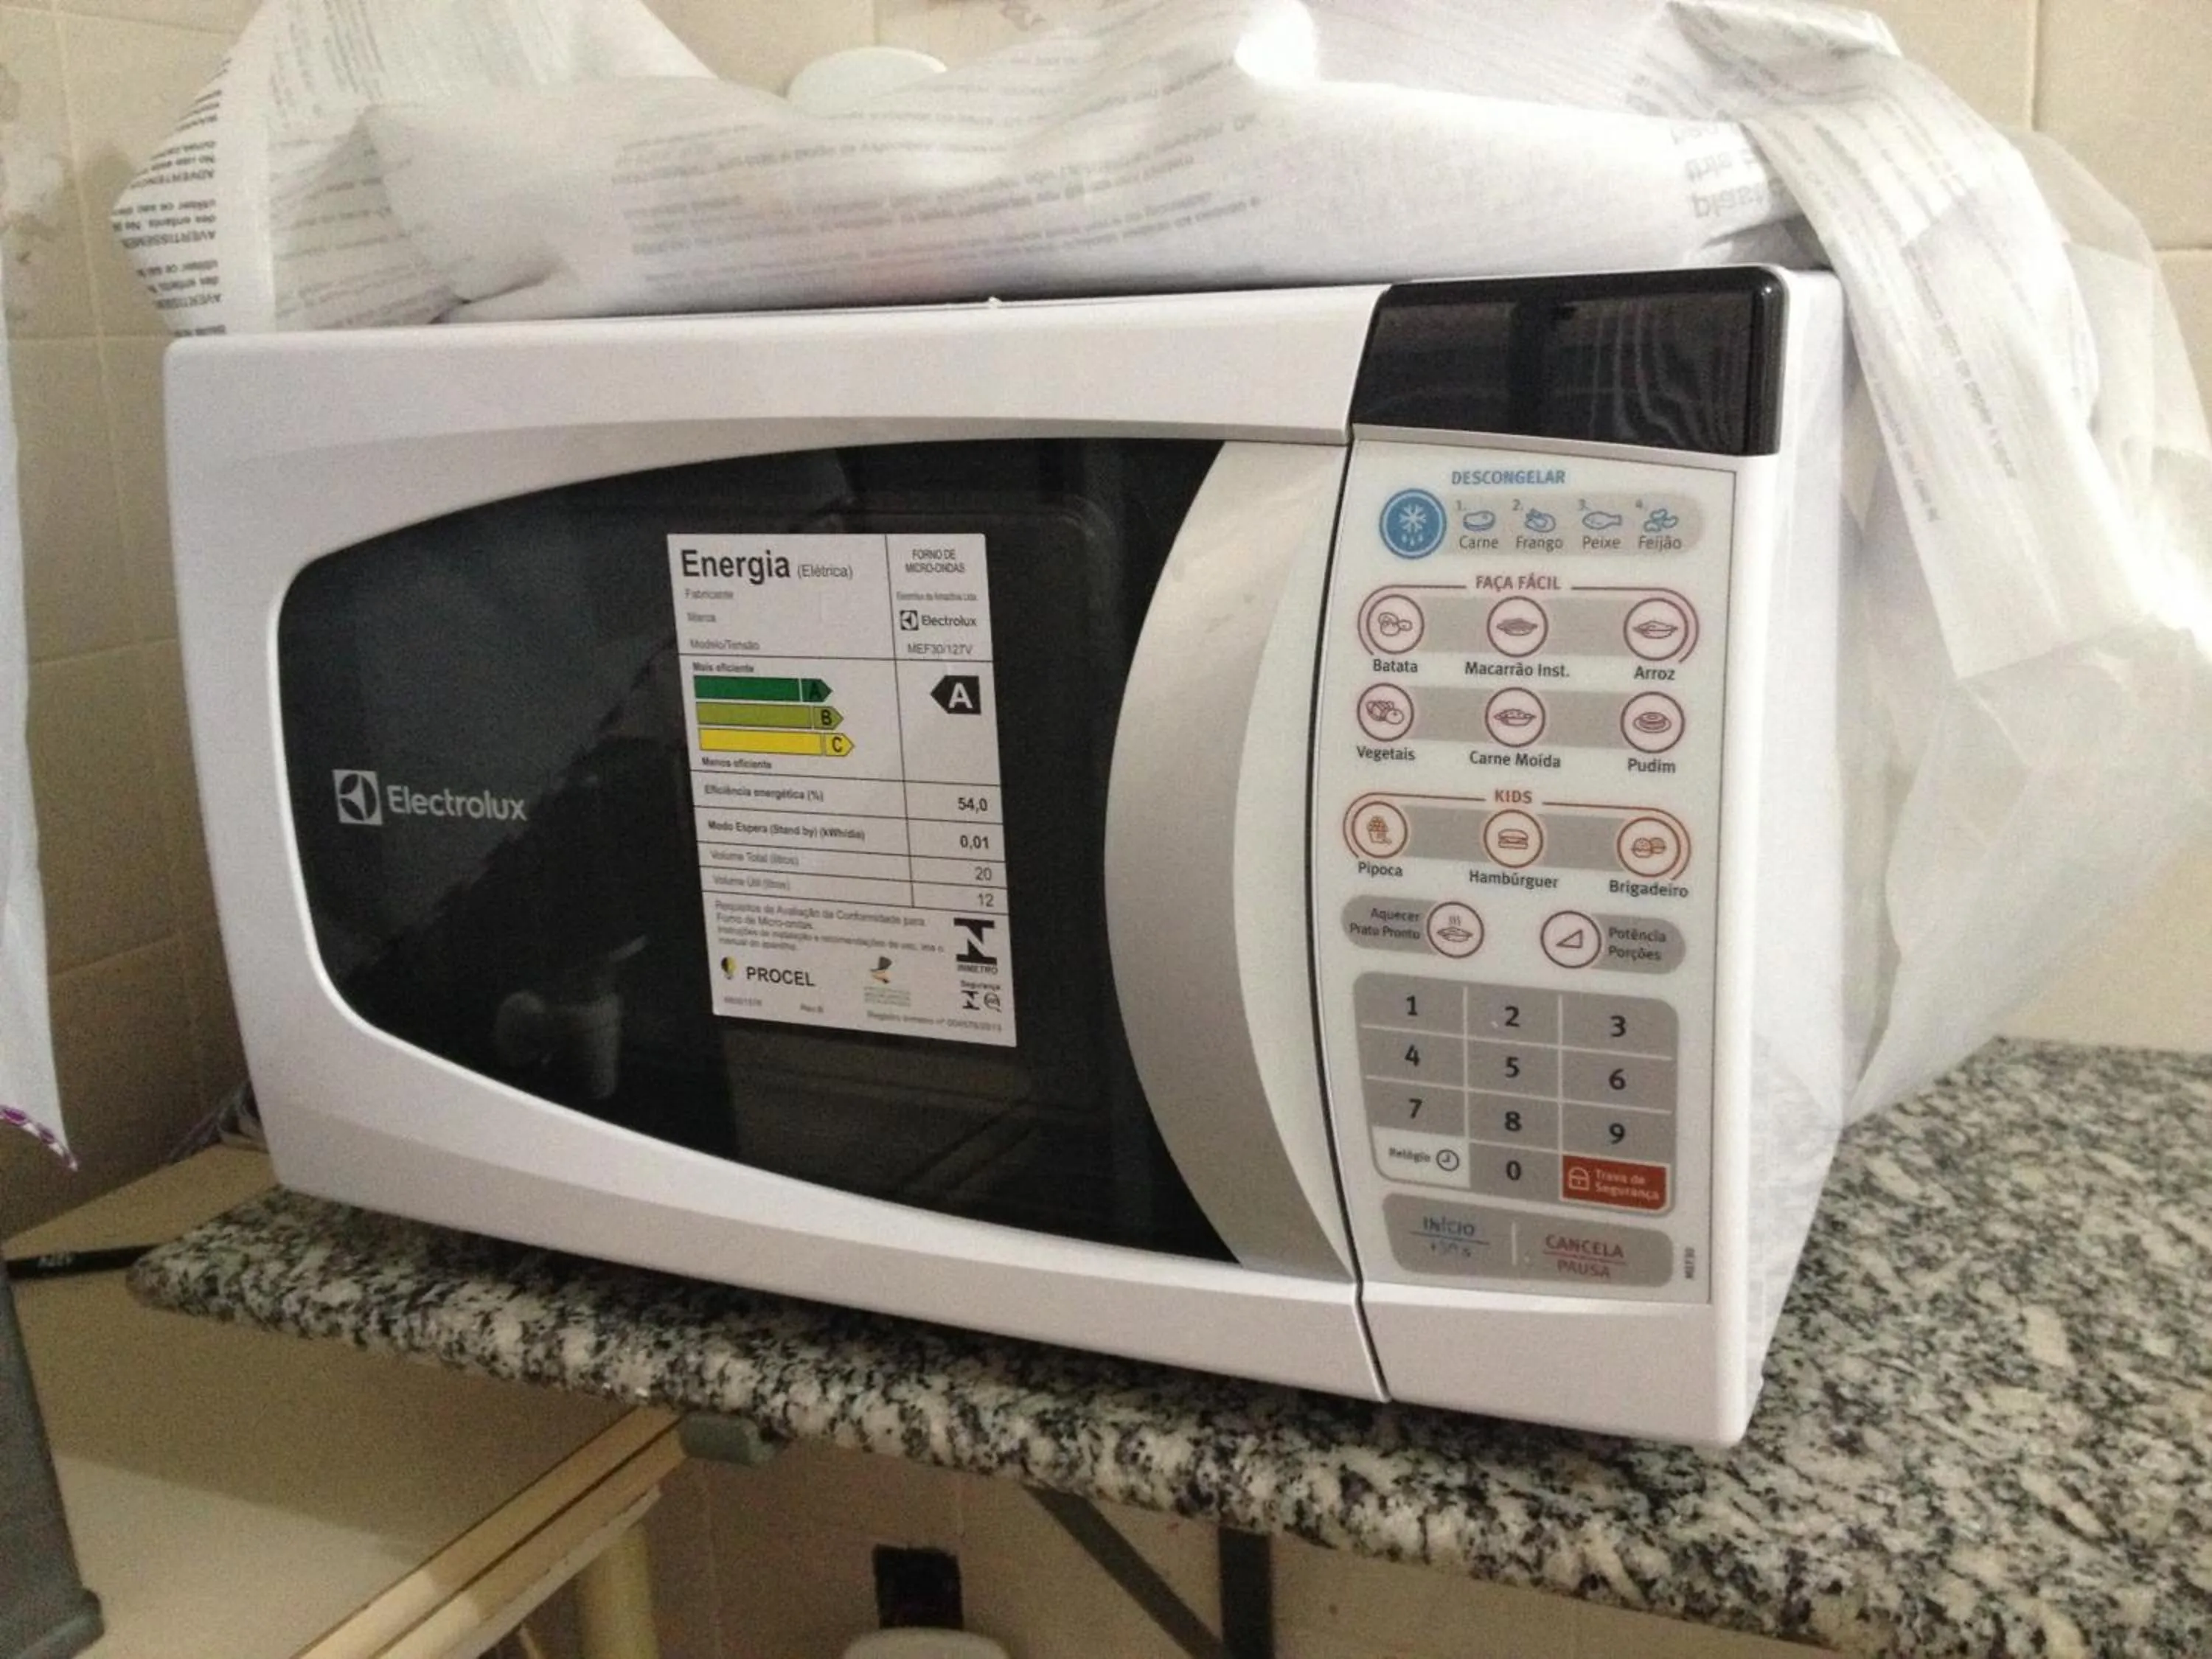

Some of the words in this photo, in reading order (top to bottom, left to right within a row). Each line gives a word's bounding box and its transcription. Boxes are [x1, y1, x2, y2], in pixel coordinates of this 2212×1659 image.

[1452, 470, 1566, 485] DESCONGELAR
[1459, 535, 1498, 550] Carne
[1516, 535, 1564, 552] Frango
[1582, 536, 1621, 550] Peixe
[1638, 535, 1682, 552] Feijão
[912, 548, 942, 560] FORNO
[944, 549, 956, 560] DE
[681, 549, 790, 584] Energia
[797, 563, 854, 580] (Elétrica)
[905, 563, 965, 574] MICRO-ONDAS
[1475, 575, 1513, 592] FAÇA
[1518, 573, 1562, 591] FÁCIL
[921, 614, 978, 627] Electrolux
[1373, 660, 1419, 674] Batata
[1464, 661, 1533, 677] Macarrão
[1537, 663, 1571, 678] Inst.
[1633, 666, 1676, 681] Arroz
[810, 682, 822, 698] A
[948, 682, 973, 709] A
[821, 709, 832, 726] B
[831, 737, 842, 753] C
[1356, 745, 1416, 762] Vegetais
[1470, 751, 1511, 767] Carne
[1515, 752, 1561, 768] Moída
[1627, 758, 1676, 773] Pudim
[386, 785, 527, 821] Electrolux
[958, 797, 988, 813] 54,0
[1495, 790, 1533, 804] KIDS
[960, 835, 990, 850] 0,01
[975, 866, 992, 881] 20
[1357, 862, 1403, 879] Pipoca
[1470, 872, 1559, 890] Hambúrguer
[1609, 880, 1689, 899] Brigadeiro
[978, 893, 994, 907] 12
[1371, 908, 1421, 924] Aquecer
[1349, 923, 1380, 938] Prato
[1383, 925, 1421, 940] Pronto
[1608, 926, 1666, 944] Potência
[1608, 945, 1662, 962] Porções
[746, 967, 815, 987] PROCEL
[1405, 995, 1418, 1016] 1
[1504, 1006, 1520, 1027] 2
[1610, 1015, 1627, 1037] 3
[1405, 1046, 1420, 1067] 4
[1505, 1057, 1520, 1079] 5
[1610, 1068, 1627, 1091] 6
[1408, 1099, 1423, 1119] 7
[1504, 1111, 1522, 1132] 8
[1609, 1123, 1626, 1144] 9
[1506, 1160, 1522, 1180] 0
[1595, 1181, 1660, 1202] Segurança
[1423, 1215, 1475, 1237] INÍCIO
[1545, 1233, 1625, 1258] CANCELA
[1557, 1259, 1612, 1279] PAUSA
